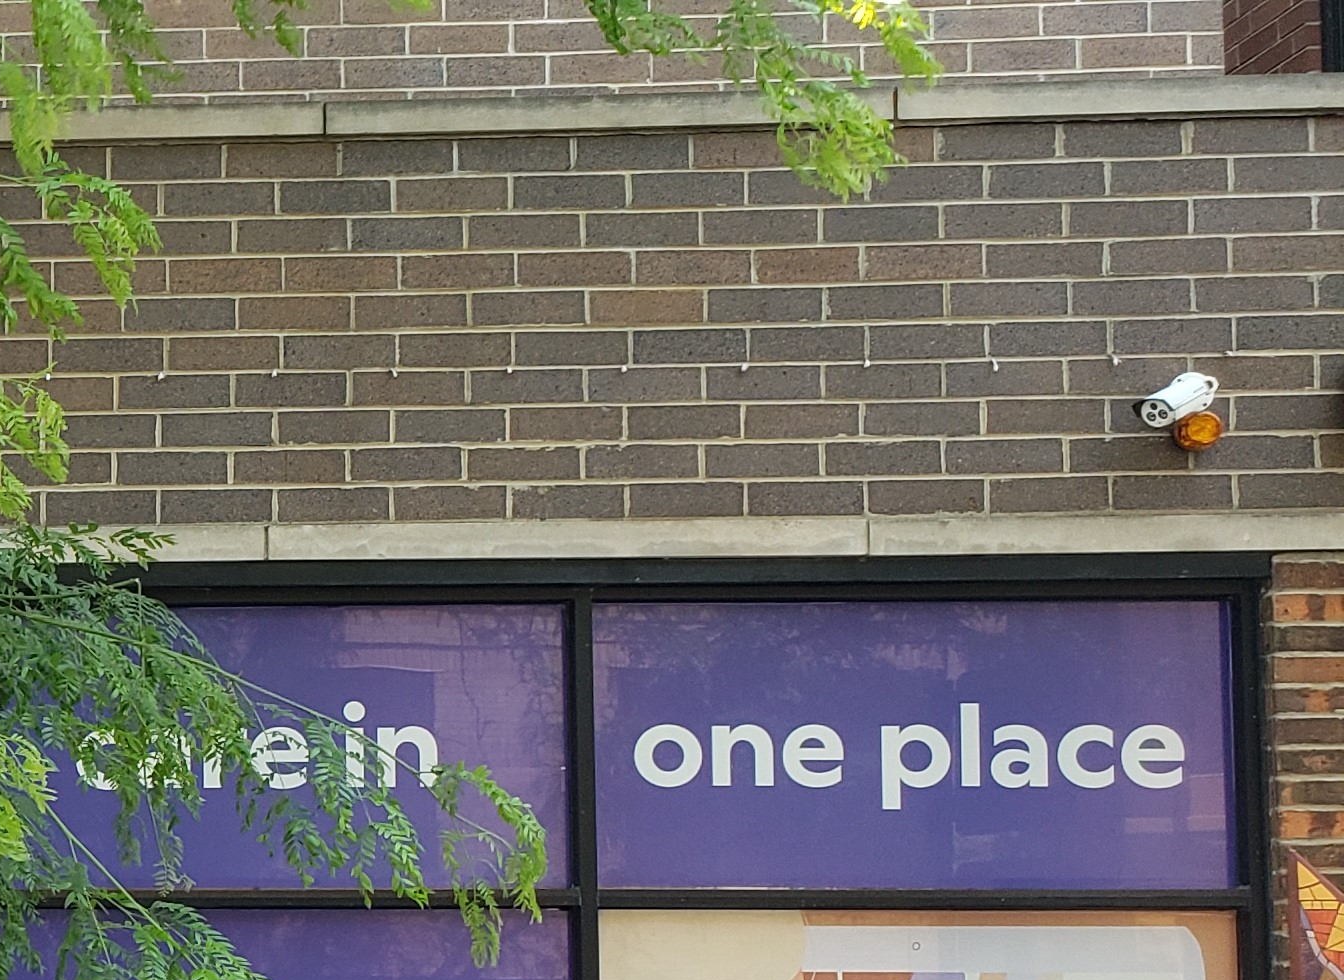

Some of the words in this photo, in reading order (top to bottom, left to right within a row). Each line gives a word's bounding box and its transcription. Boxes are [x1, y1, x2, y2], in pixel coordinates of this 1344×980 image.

[343, 701, 439, 789] in
[633, 724, 845, 788] one
[880, 703, 1186, 810] place
